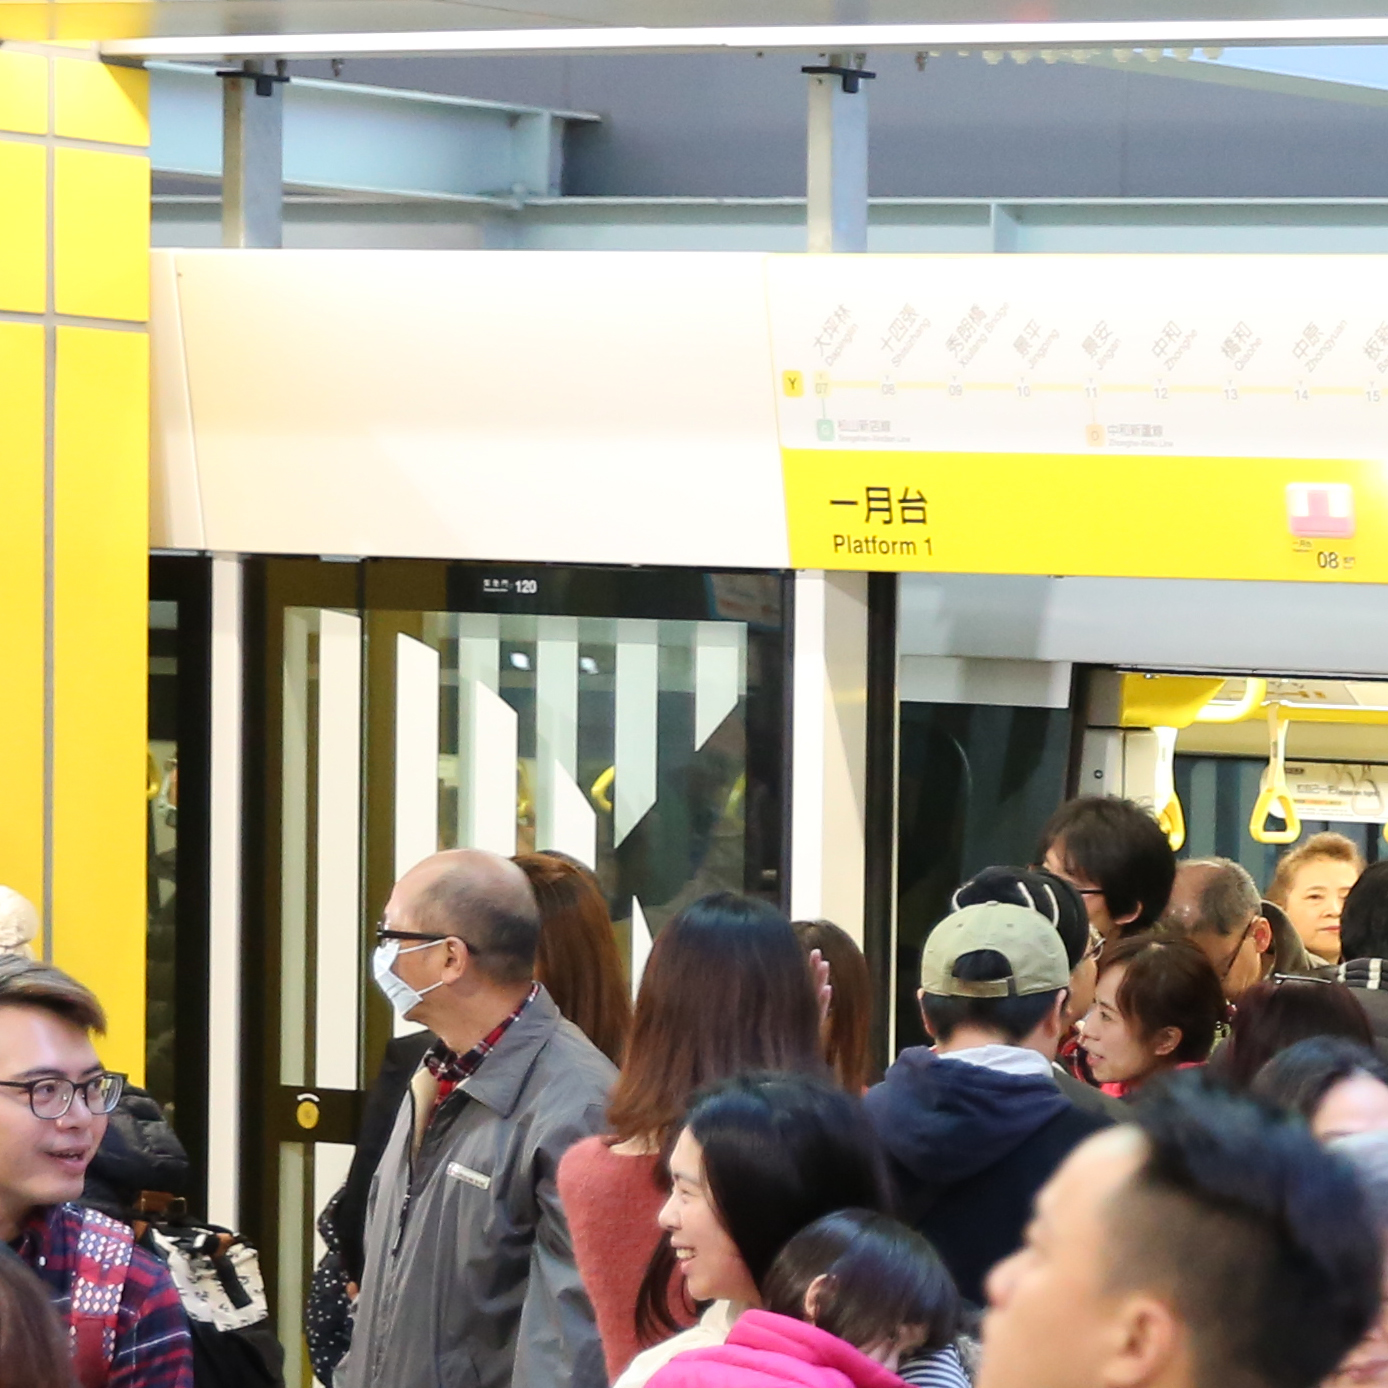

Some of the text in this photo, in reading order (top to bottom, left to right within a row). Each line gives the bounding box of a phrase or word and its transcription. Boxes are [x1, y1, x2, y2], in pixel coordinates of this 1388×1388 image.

[1151, 320, 1183, 358] 中和
[787, 377, 797, 391] Y
[1017, 386, 1031, 397] 10
[1085, 387, 1097, 398] 11
[1154, 388, 1168, 399] 12
[1224, 388, 1238, 400] 13
[1294, 389, 1309, 401] 14
[1366, 390, 1380, 401] 15
[829, 486, 928, 525] 一月台
[832, 534, 932, 558] Platform 1
[1317, 550, 1339, 569] 08
[515, 579, 538, 594] 120
